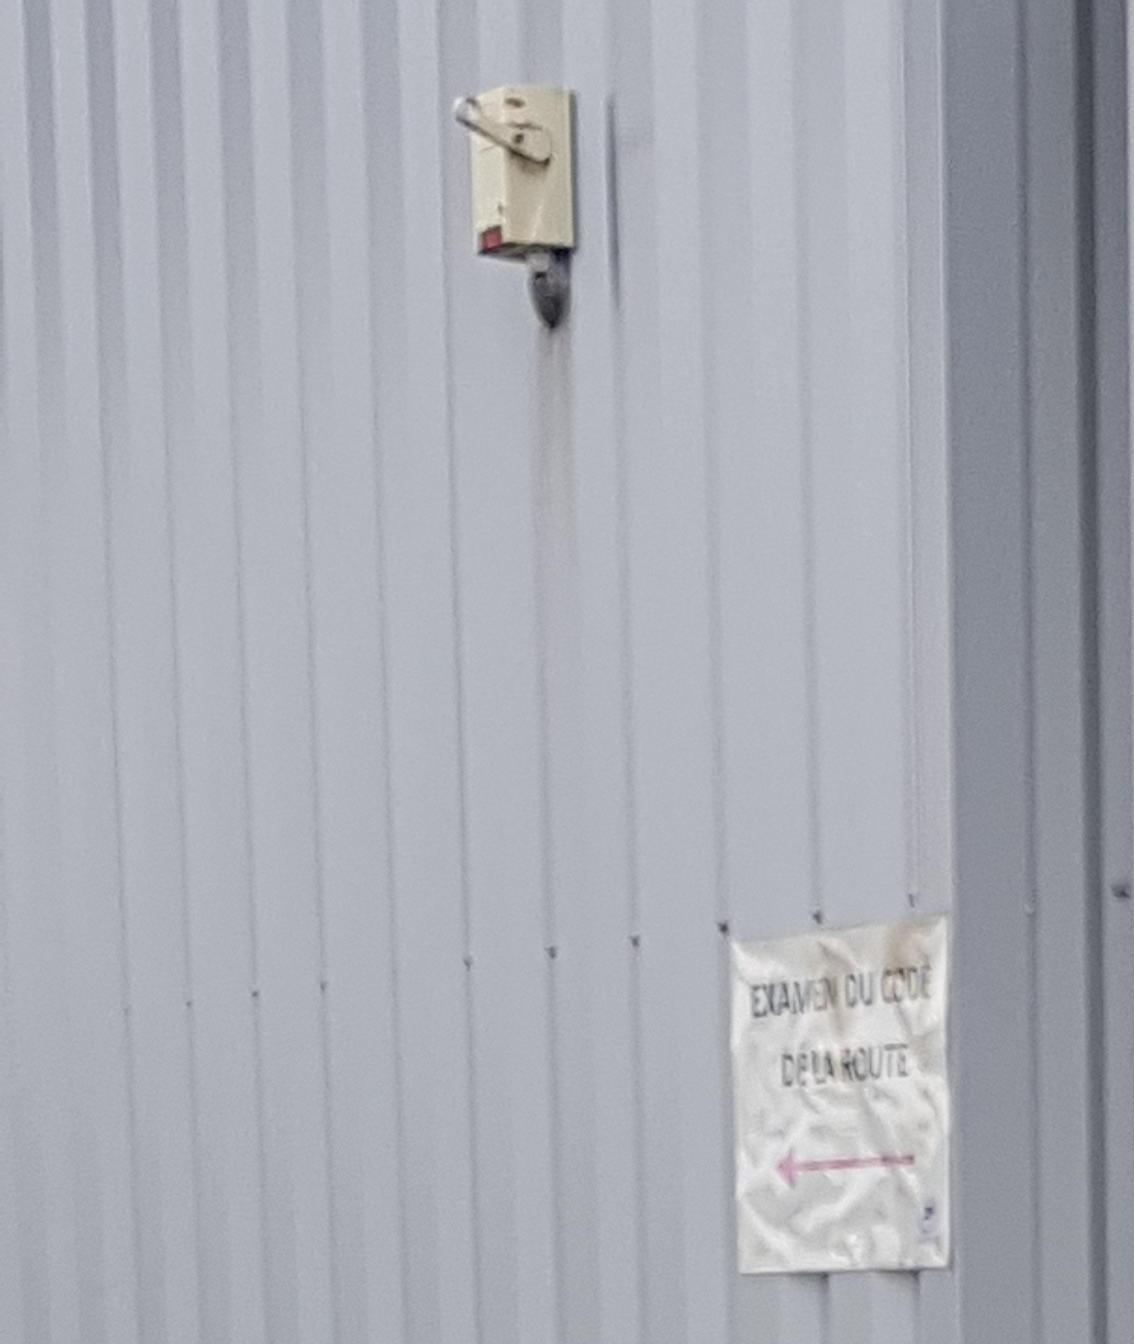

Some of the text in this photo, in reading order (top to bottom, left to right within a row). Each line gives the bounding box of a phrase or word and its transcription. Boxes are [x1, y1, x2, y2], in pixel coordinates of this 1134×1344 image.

[753, 978, 840, 1018] EXAMEN
[845, 973, 874, 1008] DU
[782, 1053, 808, 1087] DE
[840, 1043, 909, 1082] ROUTE
